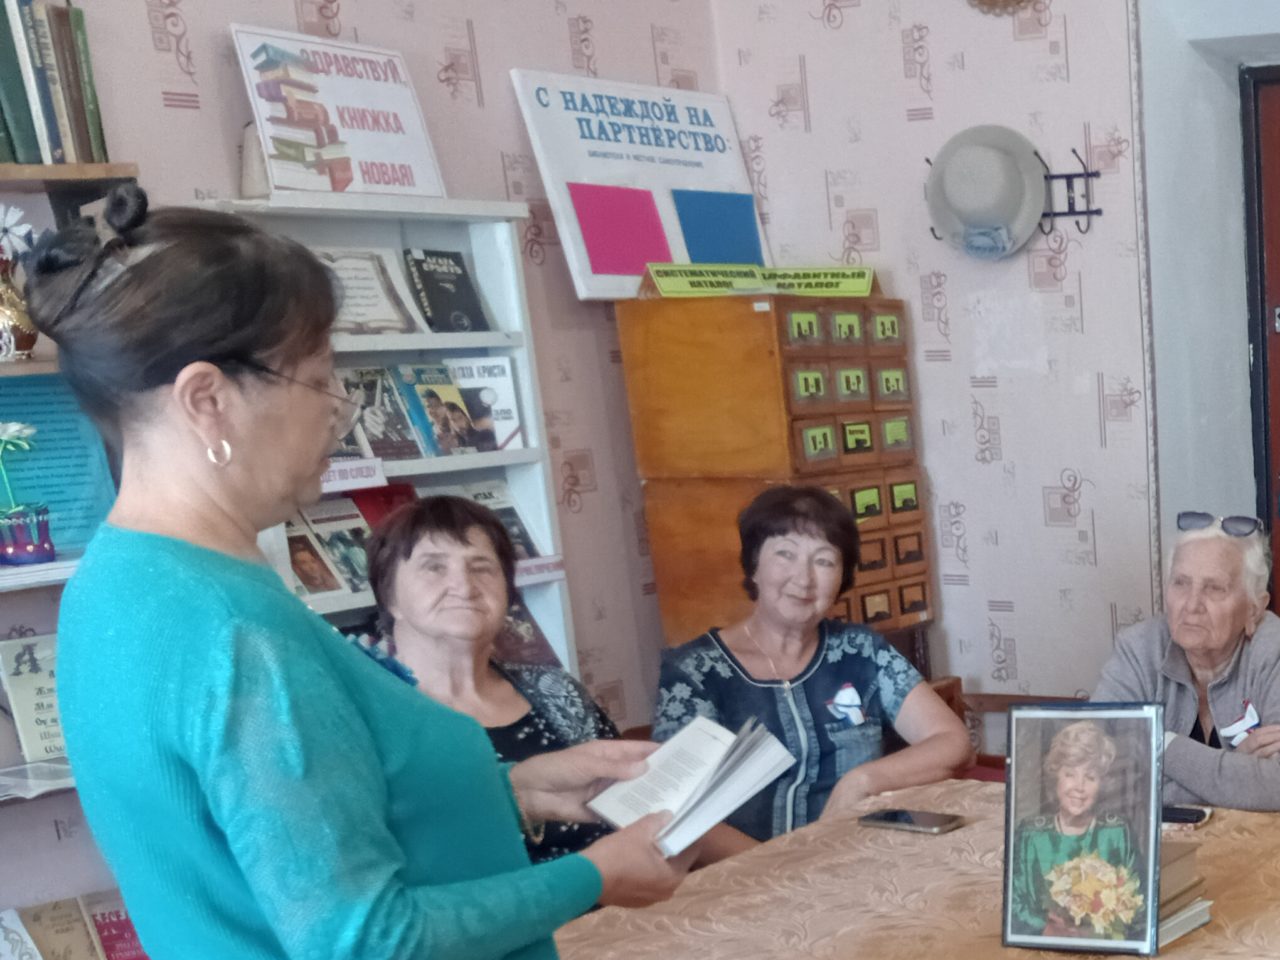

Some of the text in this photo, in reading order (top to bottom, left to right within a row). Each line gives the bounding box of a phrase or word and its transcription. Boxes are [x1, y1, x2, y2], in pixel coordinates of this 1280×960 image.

[335, 105, 406, 135] КНИЖКА
[535, 86, 715, 128] С НАДЕЖДОЙ НА
[358, 160, 416, 187] НОВАЯ!
[655, 268, 757, 279] СИСТЕМАТИЧЕСКИЙ
[776, 281, 842, 289] КАТАЛОГ
